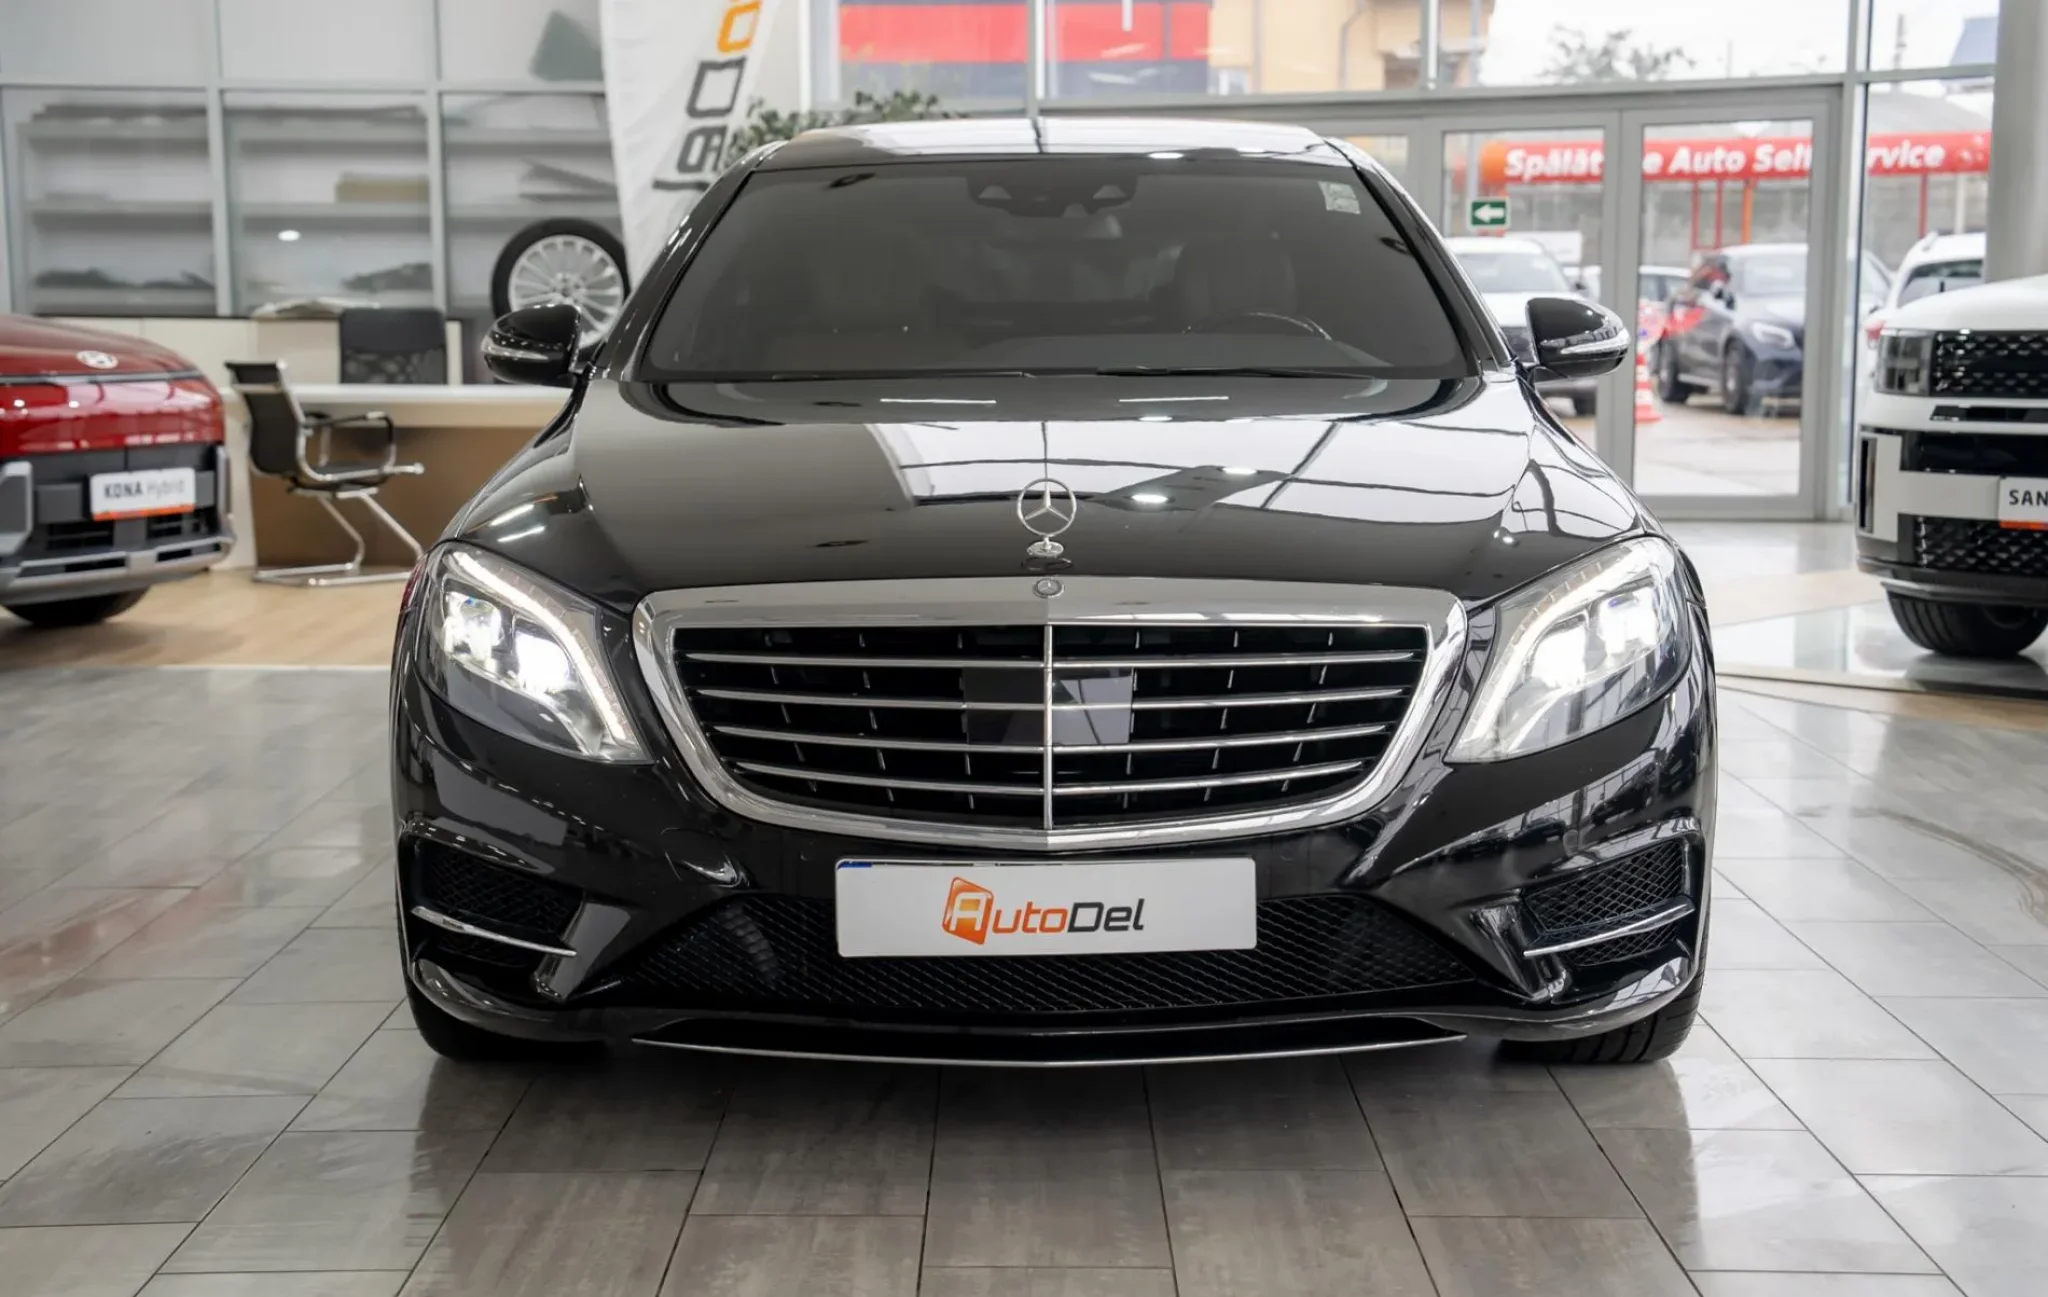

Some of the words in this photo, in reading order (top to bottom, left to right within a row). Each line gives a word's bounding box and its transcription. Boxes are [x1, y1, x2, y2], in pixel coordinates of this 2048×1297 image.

[1668, 144, 1747, 174] Auto
[1866, 138, 1946, 169] rvice
[104, 481, 143, 498] KONA
[942, 876, 1146, 946] AutoDel
